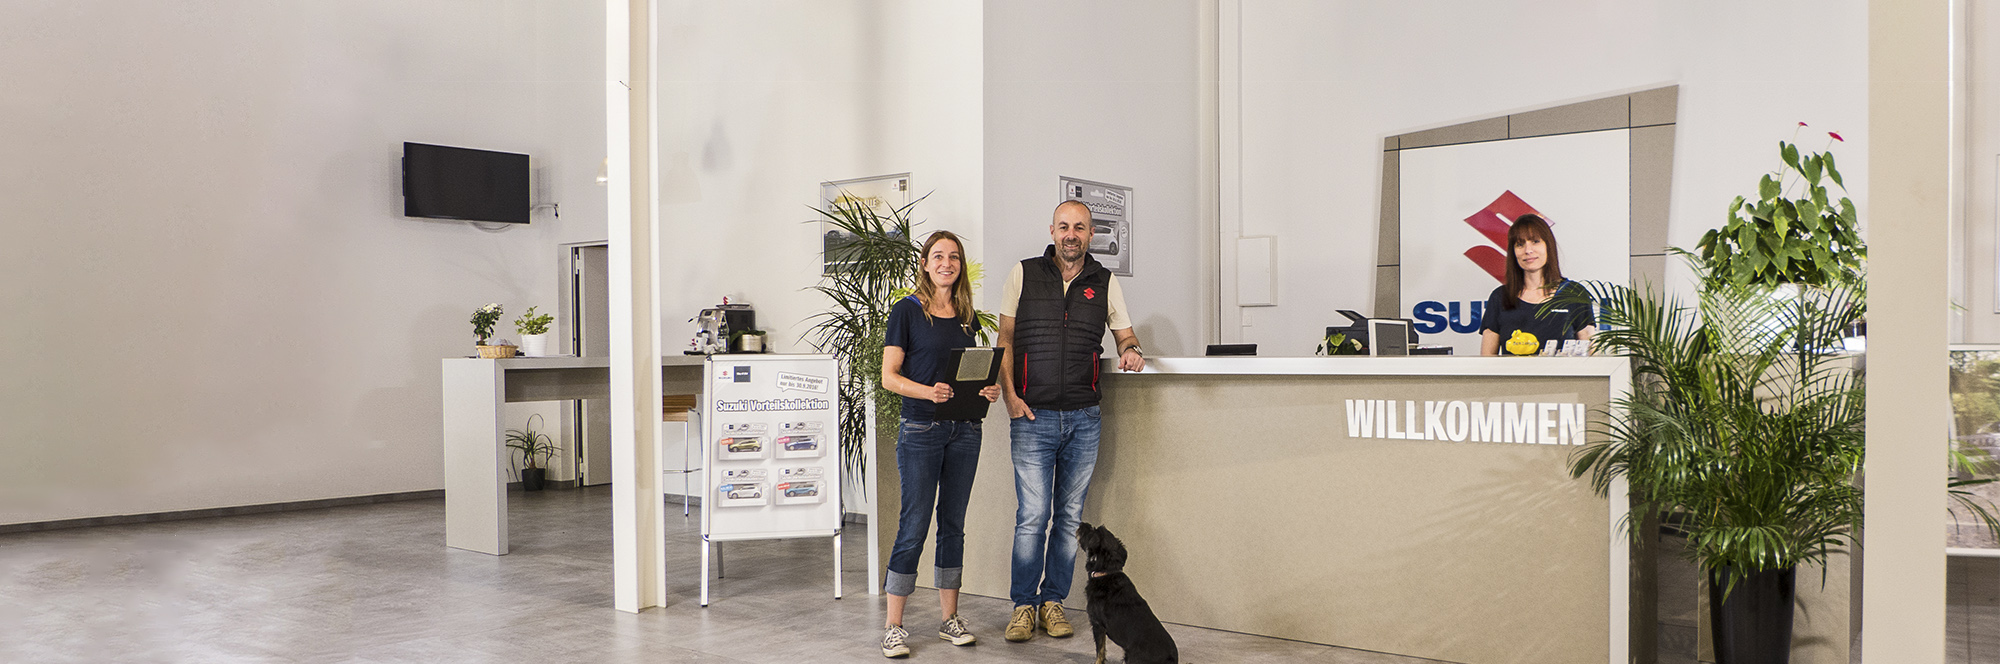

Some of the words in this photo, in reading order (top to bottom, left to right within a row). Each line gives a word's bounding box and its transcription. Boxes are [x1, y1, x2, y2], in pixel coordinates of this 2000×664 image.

[717, 399, 748, 412] Suzuki
[749, 398, 829, 411] Vorteilskollektion
[1345, 399, 1586, 446] WILLKOMMEN
